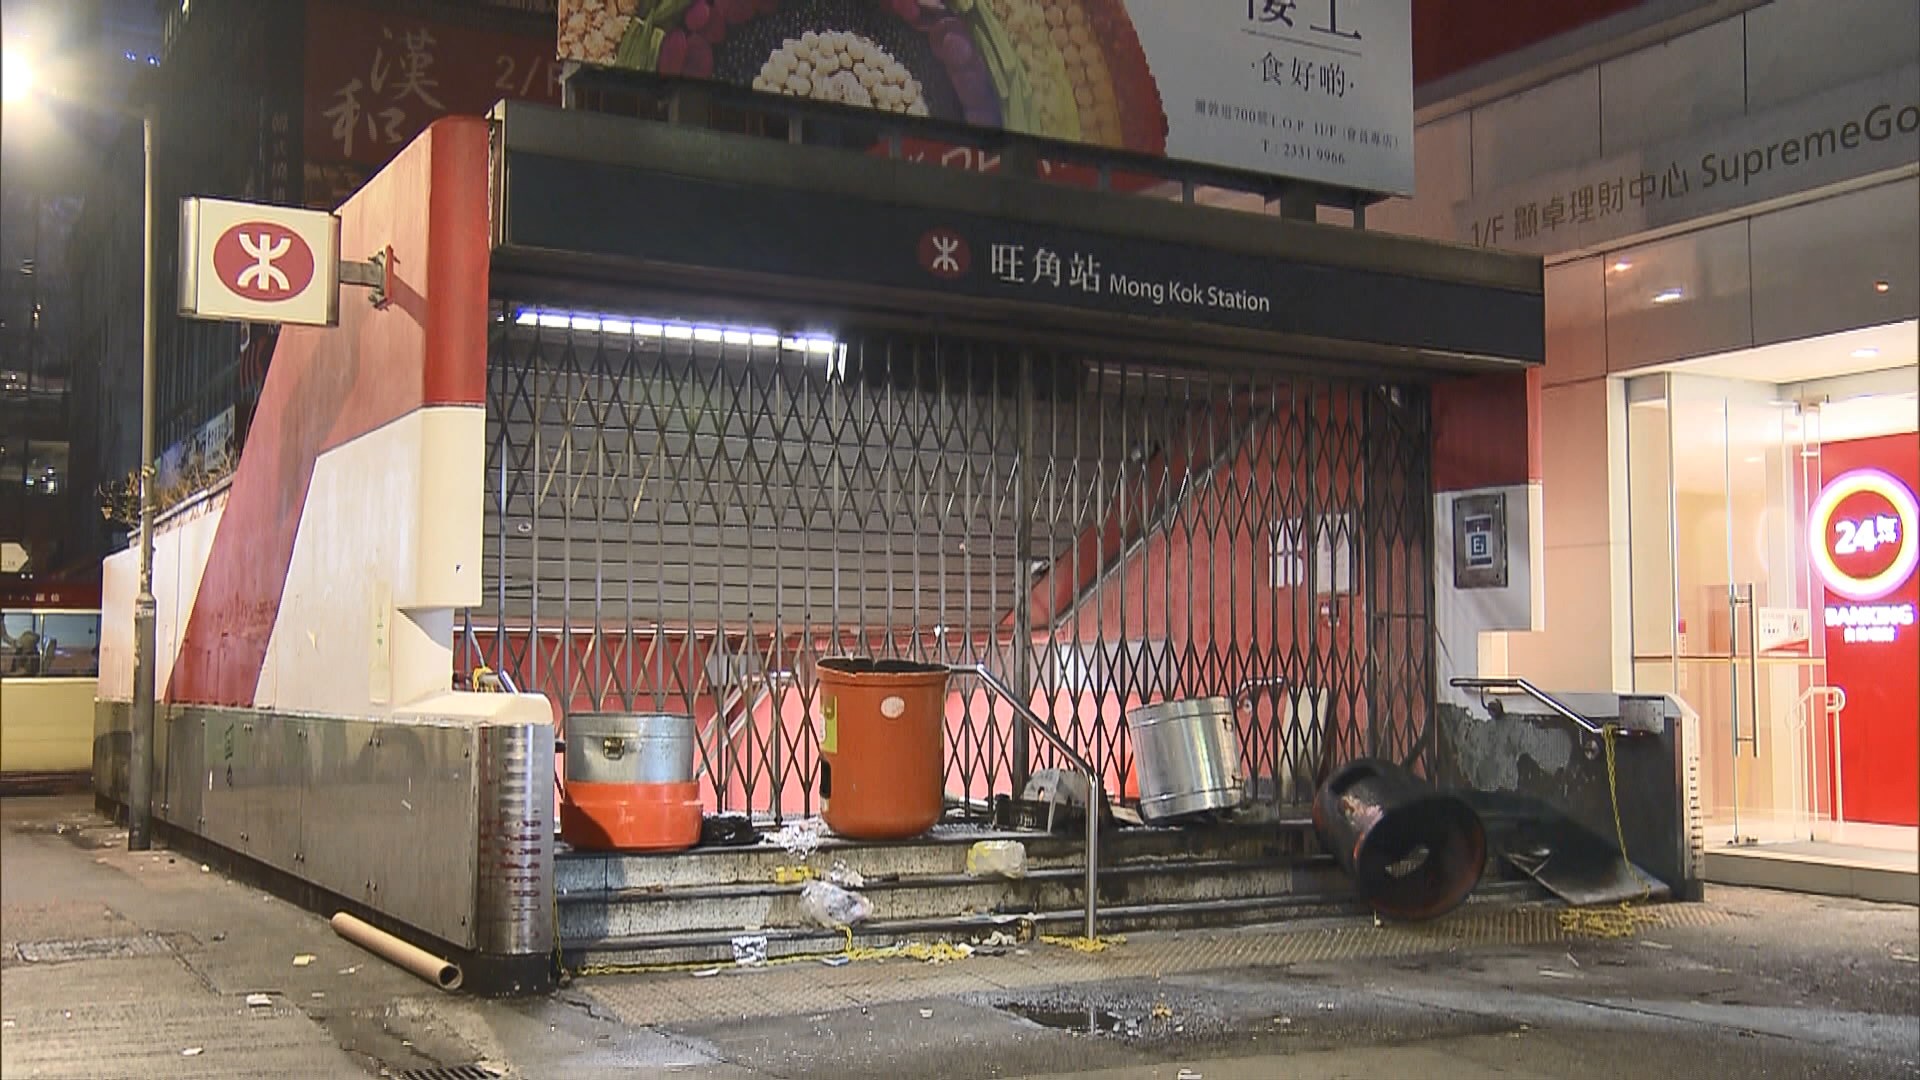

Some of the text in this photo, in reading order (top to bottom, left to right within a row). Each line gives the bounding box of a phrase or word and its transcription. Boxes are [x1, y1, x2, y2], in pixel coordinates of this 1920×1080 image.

[990, 242, 1270, 312] 旺角站 Mong Kok Station
